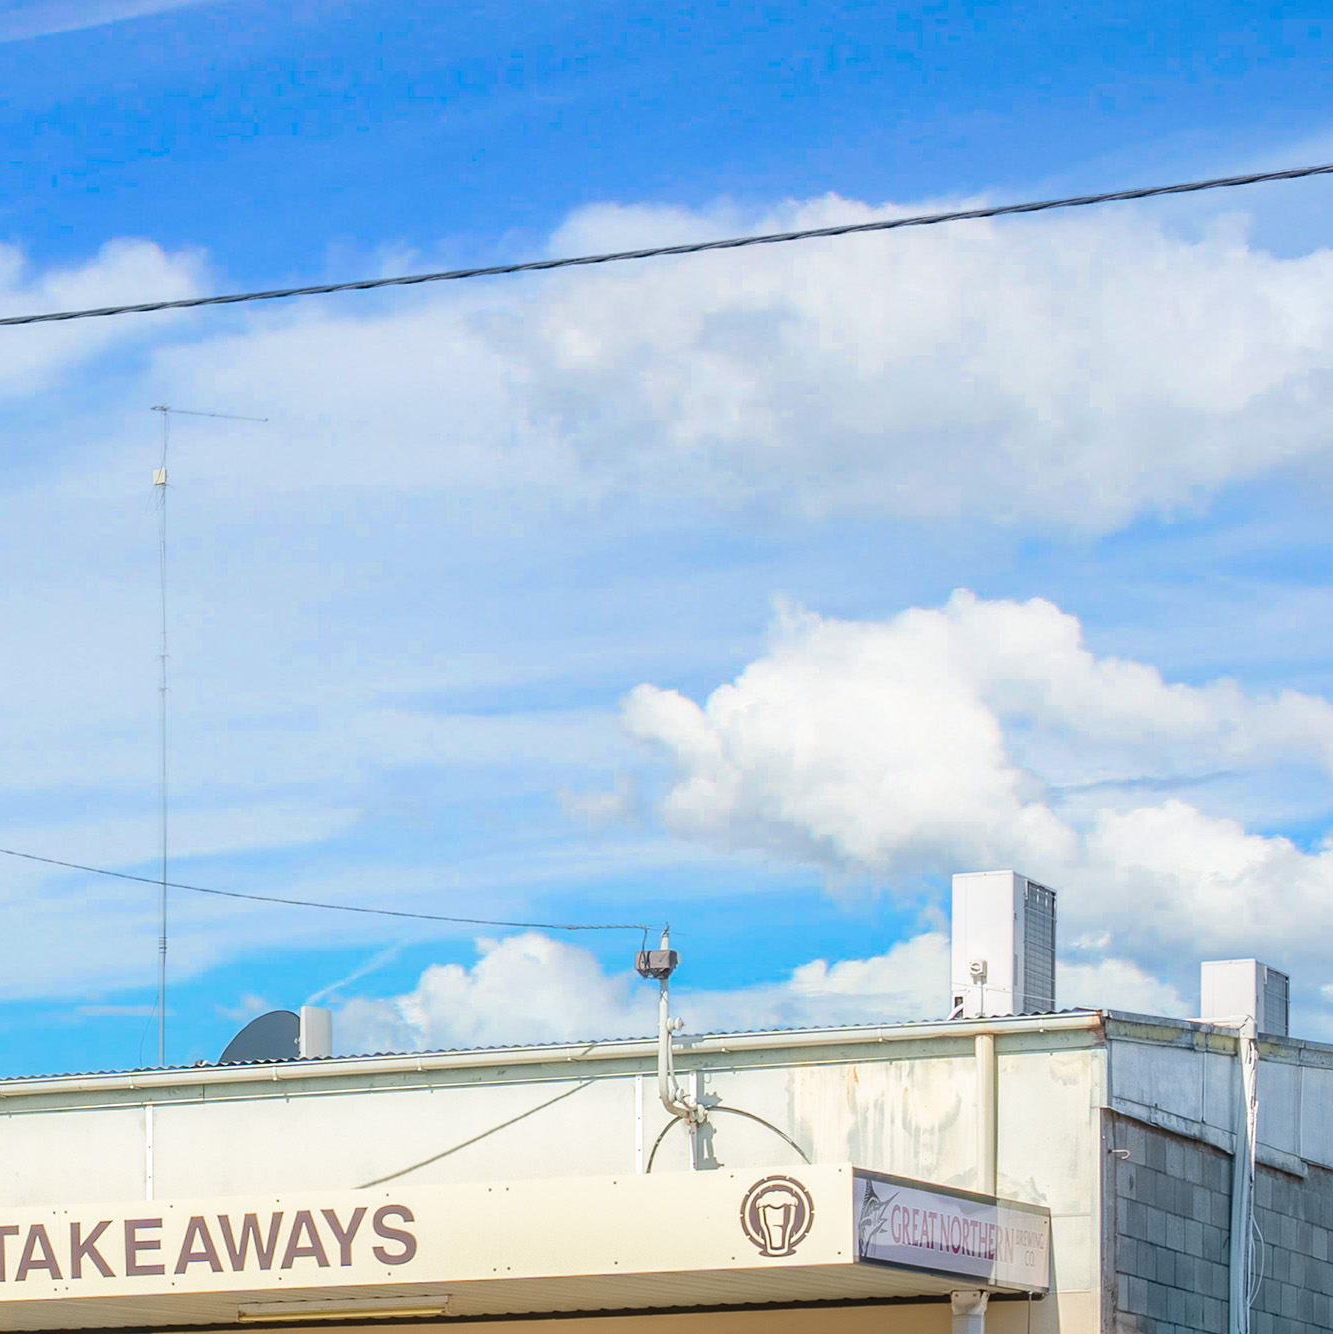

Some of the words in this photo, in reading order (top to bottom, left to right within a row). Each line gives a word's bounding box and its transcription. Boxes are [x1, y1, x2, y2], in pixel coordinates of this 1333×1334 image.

[890, 1204, 937, 1250] GREAT
[939, 1213, 1015, 1264] NORTHERN
[1015, 1228, 1045, 1250] BREWING
